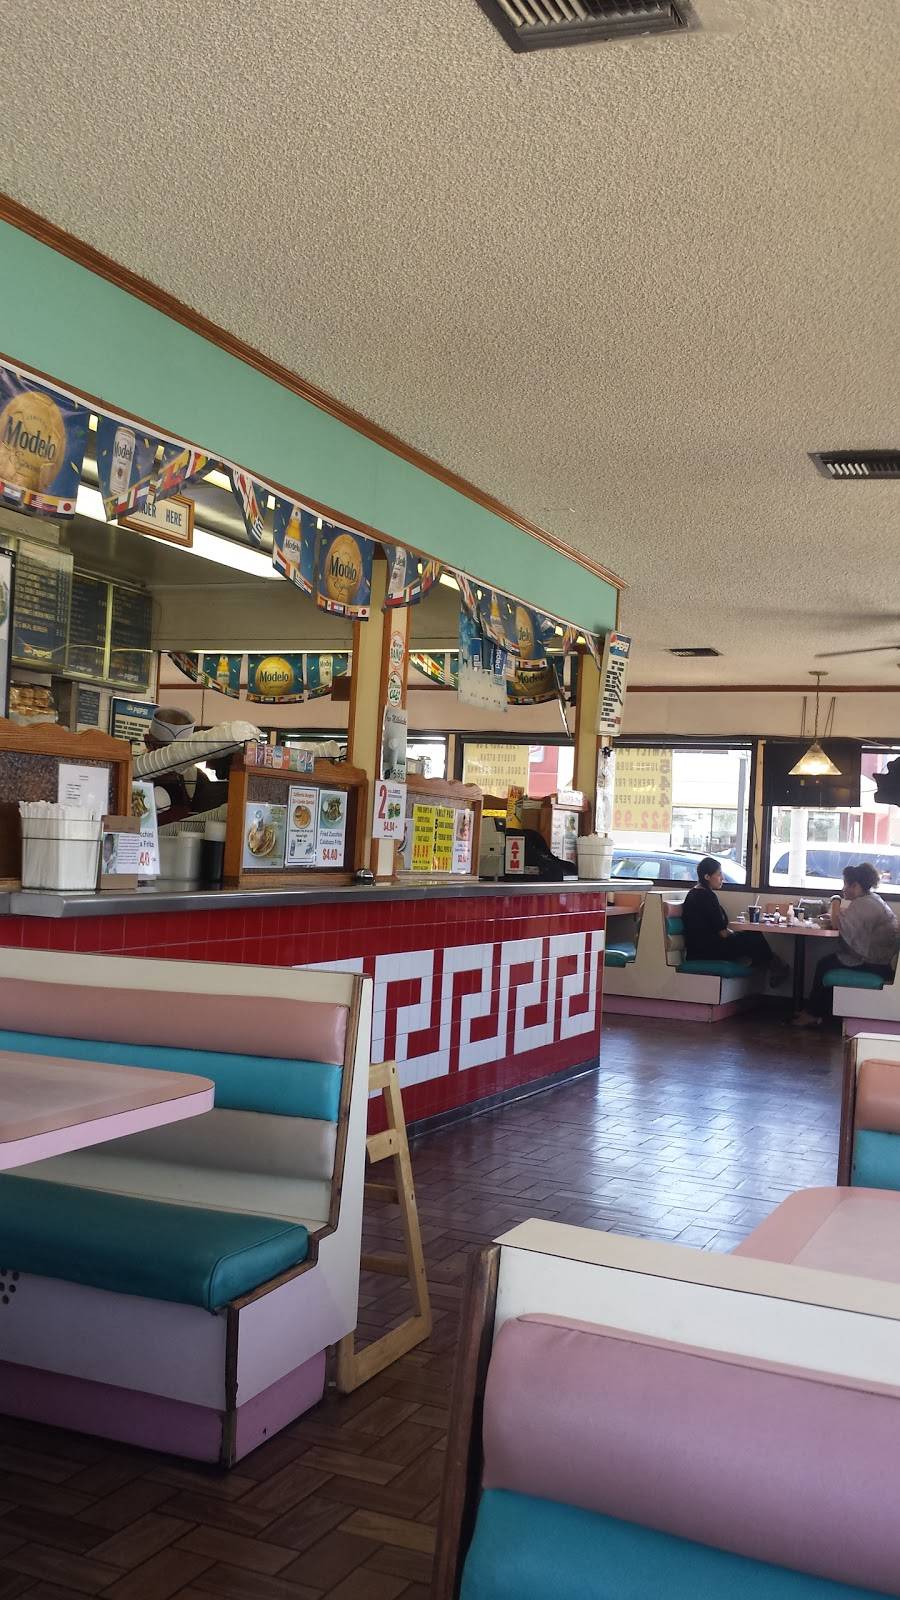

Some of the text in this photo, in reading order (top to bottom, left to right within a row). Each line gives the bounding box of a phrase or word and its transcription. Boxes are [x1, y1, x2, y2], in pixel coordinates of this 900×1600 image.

[3, 415, 56, 461] Modelo
[165, 509, 182, 526] HERE
[329, 555, 357, 580] Modelo
[259, 670, 289, 683] Modelo
[378, 784, 388, 819] 2
[510, 841, 520, 869] ATM
